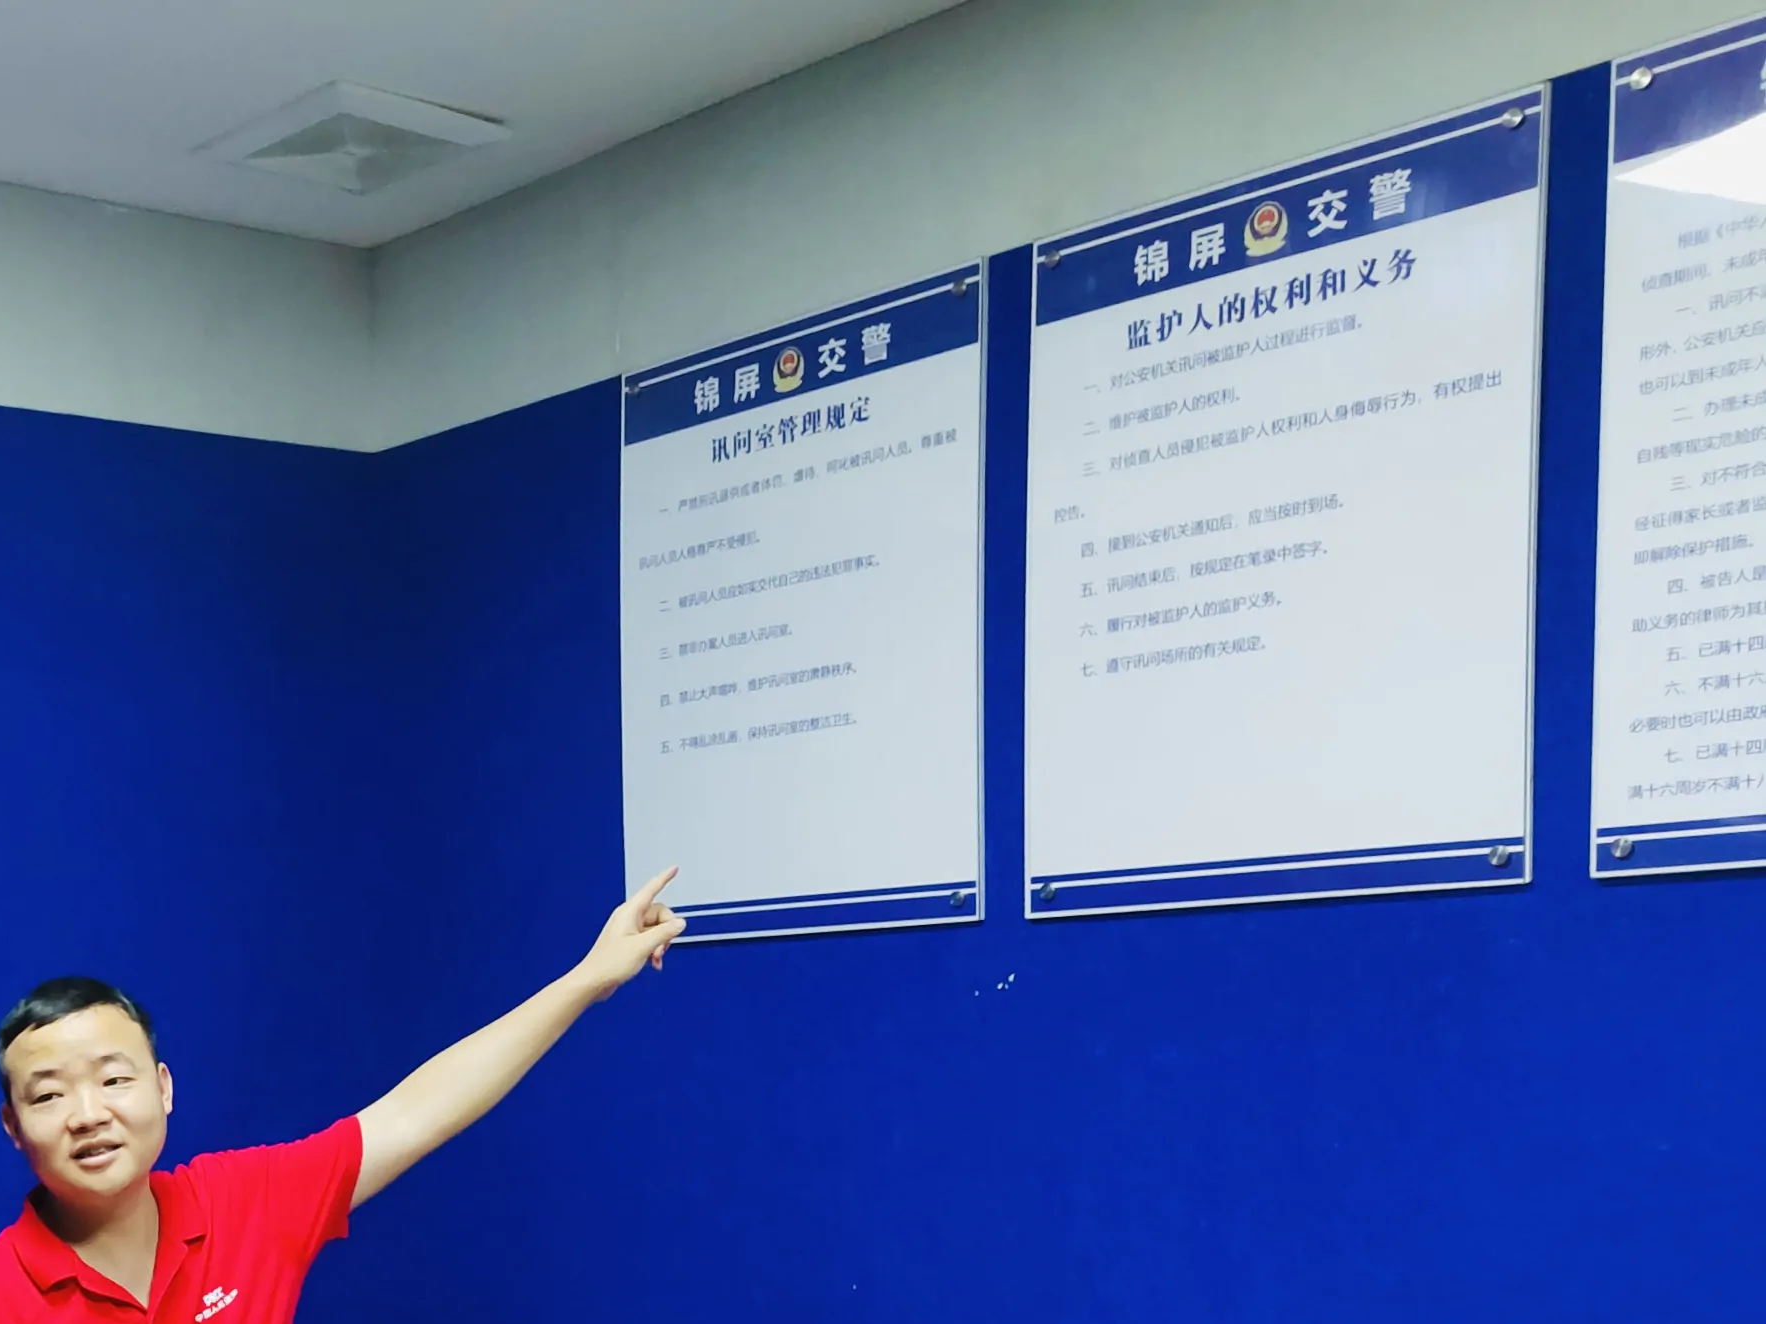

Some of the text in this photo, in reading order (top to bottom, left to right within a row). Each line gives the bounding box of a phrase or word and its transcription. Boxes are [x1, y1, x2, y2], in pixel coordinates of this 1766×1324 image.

[1132, 169, 1413, 288] 锦屏 交警
[1125, 248, 1420, 351] 监护人的权利和义务
[693, 323, 891, 413] 锦屏 交警
[711, 395, 871, 464] 讯问室管理规定
[1631, 602, 1766, 634] 助义务的律师为其
[1666, 635, 1766, 663] 五、已满十四
[1664, 738, 1766, 764] 七、已满十四
